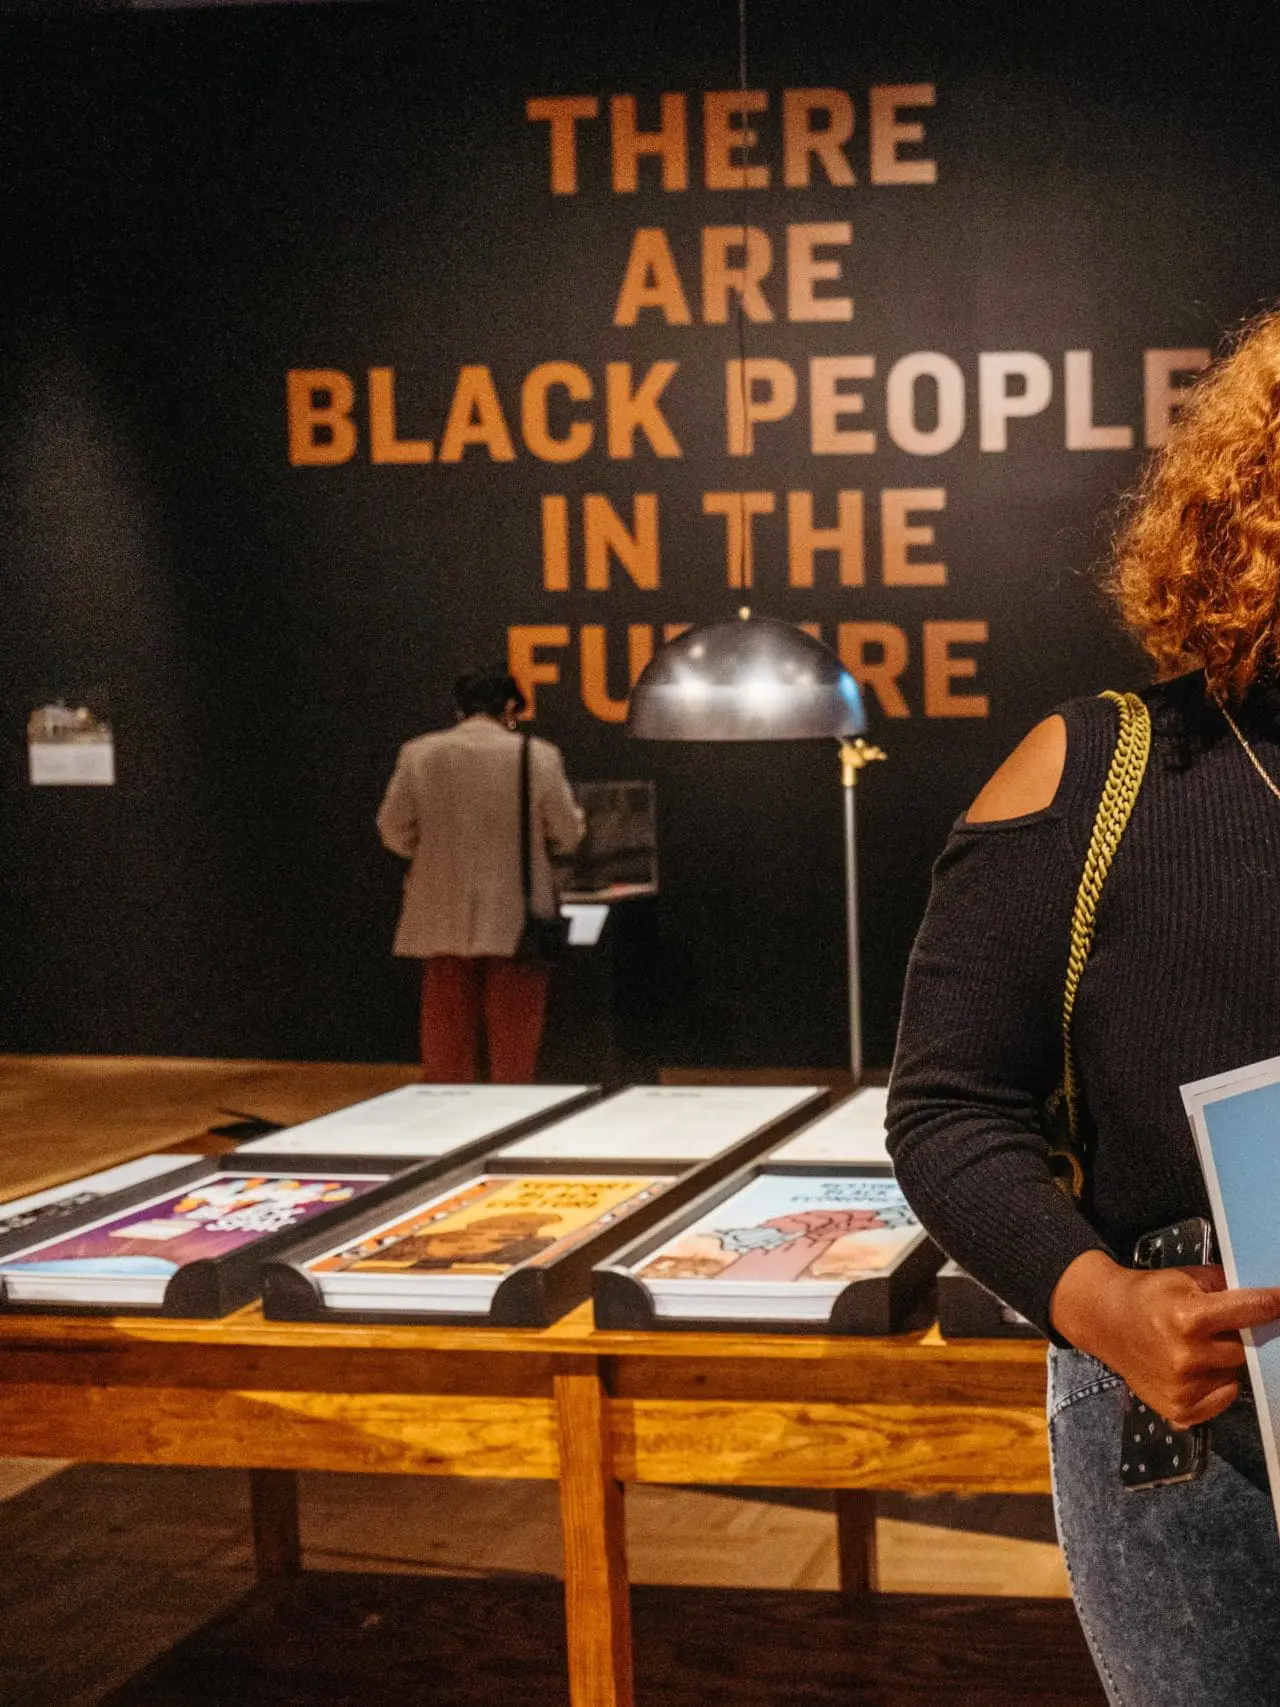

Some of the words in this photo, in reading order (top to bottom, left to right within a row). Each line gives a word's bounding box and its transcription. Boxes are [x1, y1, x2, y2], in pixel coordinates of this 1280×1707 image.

[526, 84, 938, 194] THERE
[612, 222, 855, 327] ARE
[287, 360, 683, 466] BLACK
[727, 347, 1212, 457] PEOPLE
[541, 493, 660, 592] IN
[703, 487, 948, 590] THE
[507, 620, 988, 722] FURE
